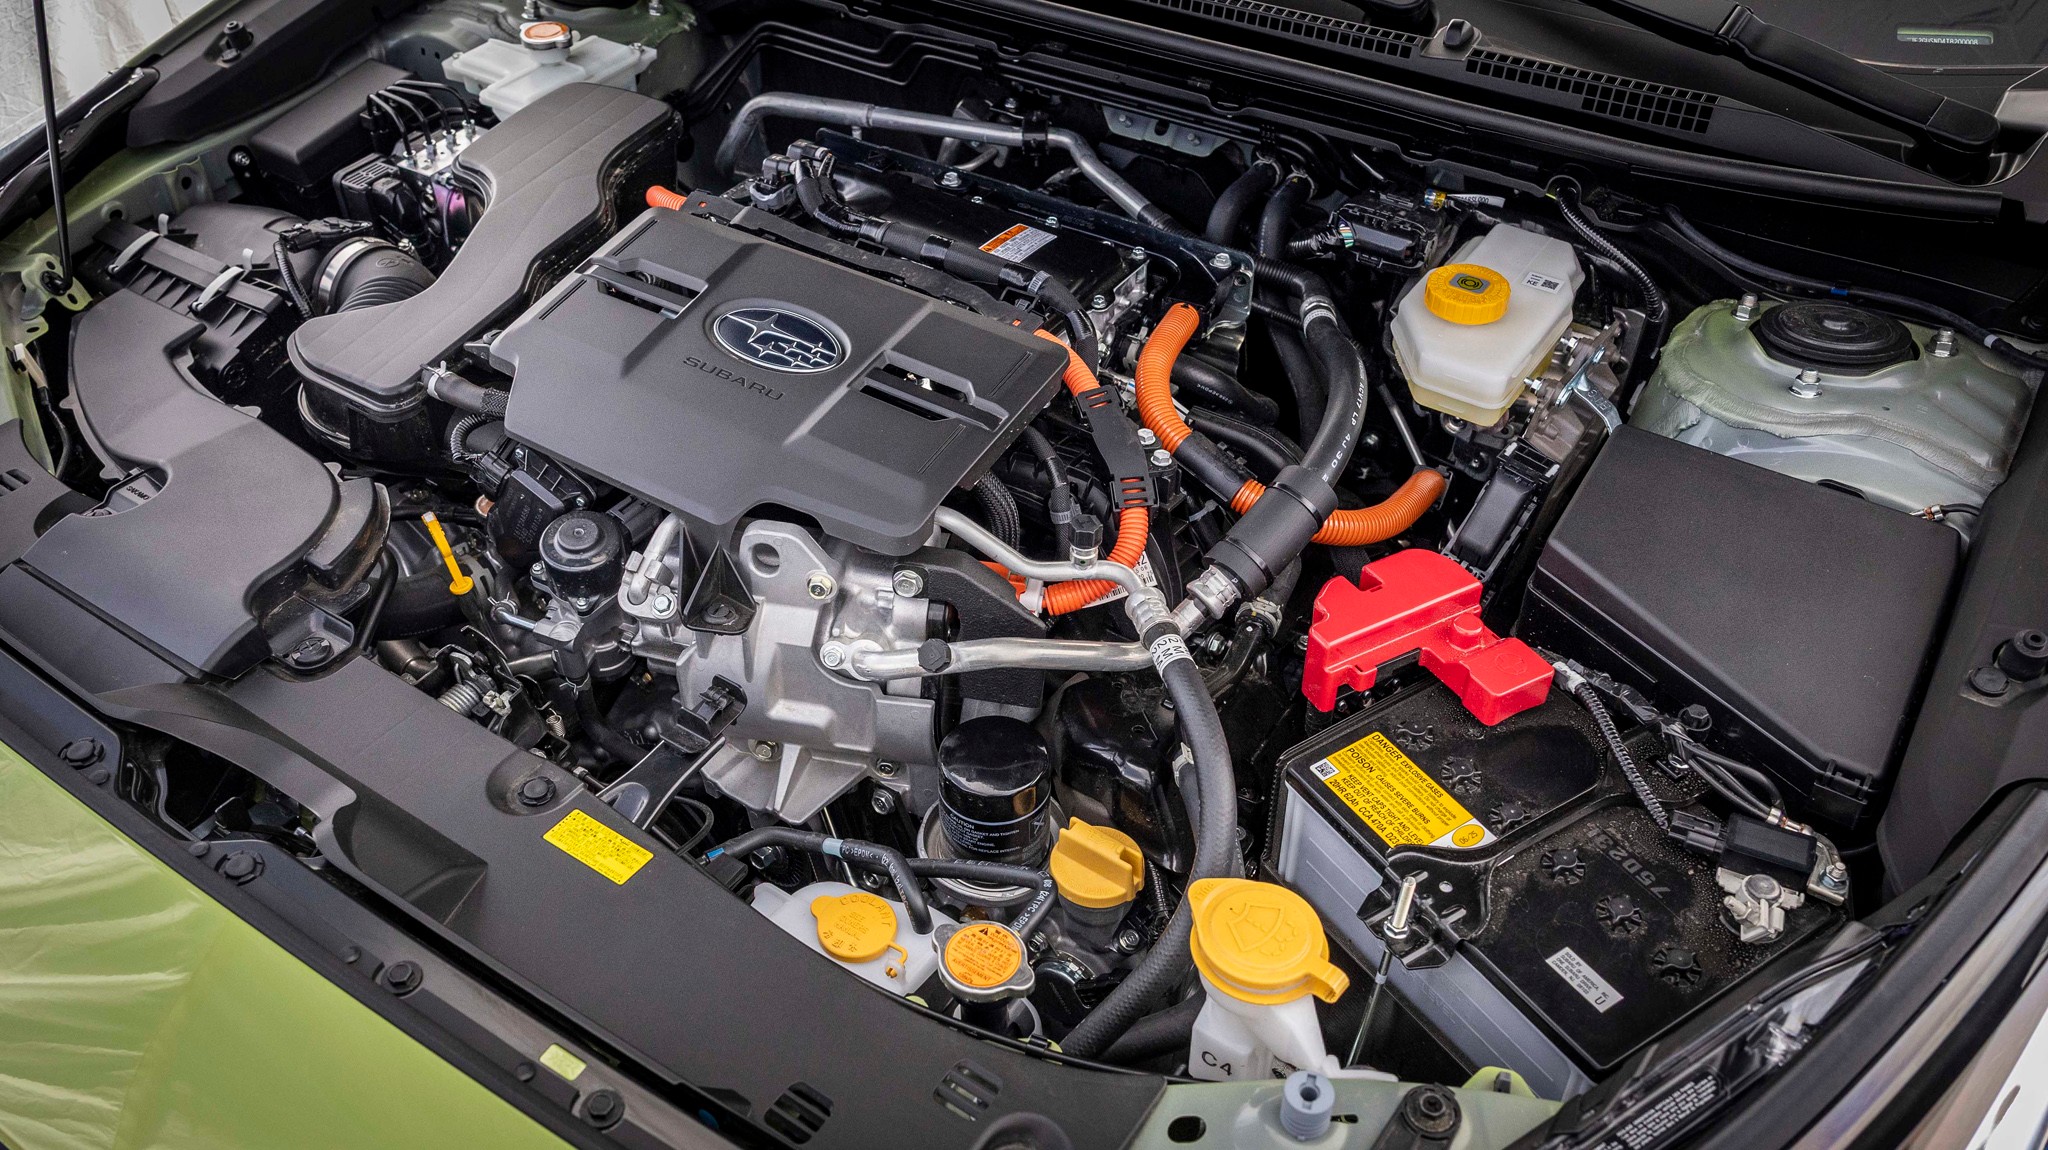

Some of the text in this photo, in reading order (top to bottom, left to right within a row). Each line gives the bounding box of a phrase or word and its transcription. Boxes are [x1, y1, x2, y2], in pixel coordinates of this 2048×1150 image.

[683, 356, 786, 400] SUBARU
[1345, 747, 1431, 824] POISON CAUSES SEVERE BURNS
[1371, 734, 1444, 798] DANGER EXPLOSIVE GASES
[950, 813, 975, 830] CAUTION
[1328, 778, 1347, 794] 20HR
[1342, 792, 1360, 806] 62Ah
[1357, 806, 1374, 820] CCA
[1369, 817, 1387, 833] 470A
[1340, 777, 1356, 790] KEEP
[1352, 788, 1365, 799] OUT
[1362, 797, 1372, 805] OF
[1369, 804, 1388, 820] REACH
[1384, 819, 1395, 827] OF
[1347, 773, 1362, 786] KEEP
[1359, 784, 1374, 797] VENT
[1371, 796, 1386, 809] CAPS
[1383, 808, 1400, 822] TIGHT
[1396, 820, 1410, 832] AND
[1458, 830, 1478, 845] 06/25
[840, 895, 892, 927] COOLANT
[1593, 995, 1606, 1006] U
[1201, 1051, 1233, 1076] C4
